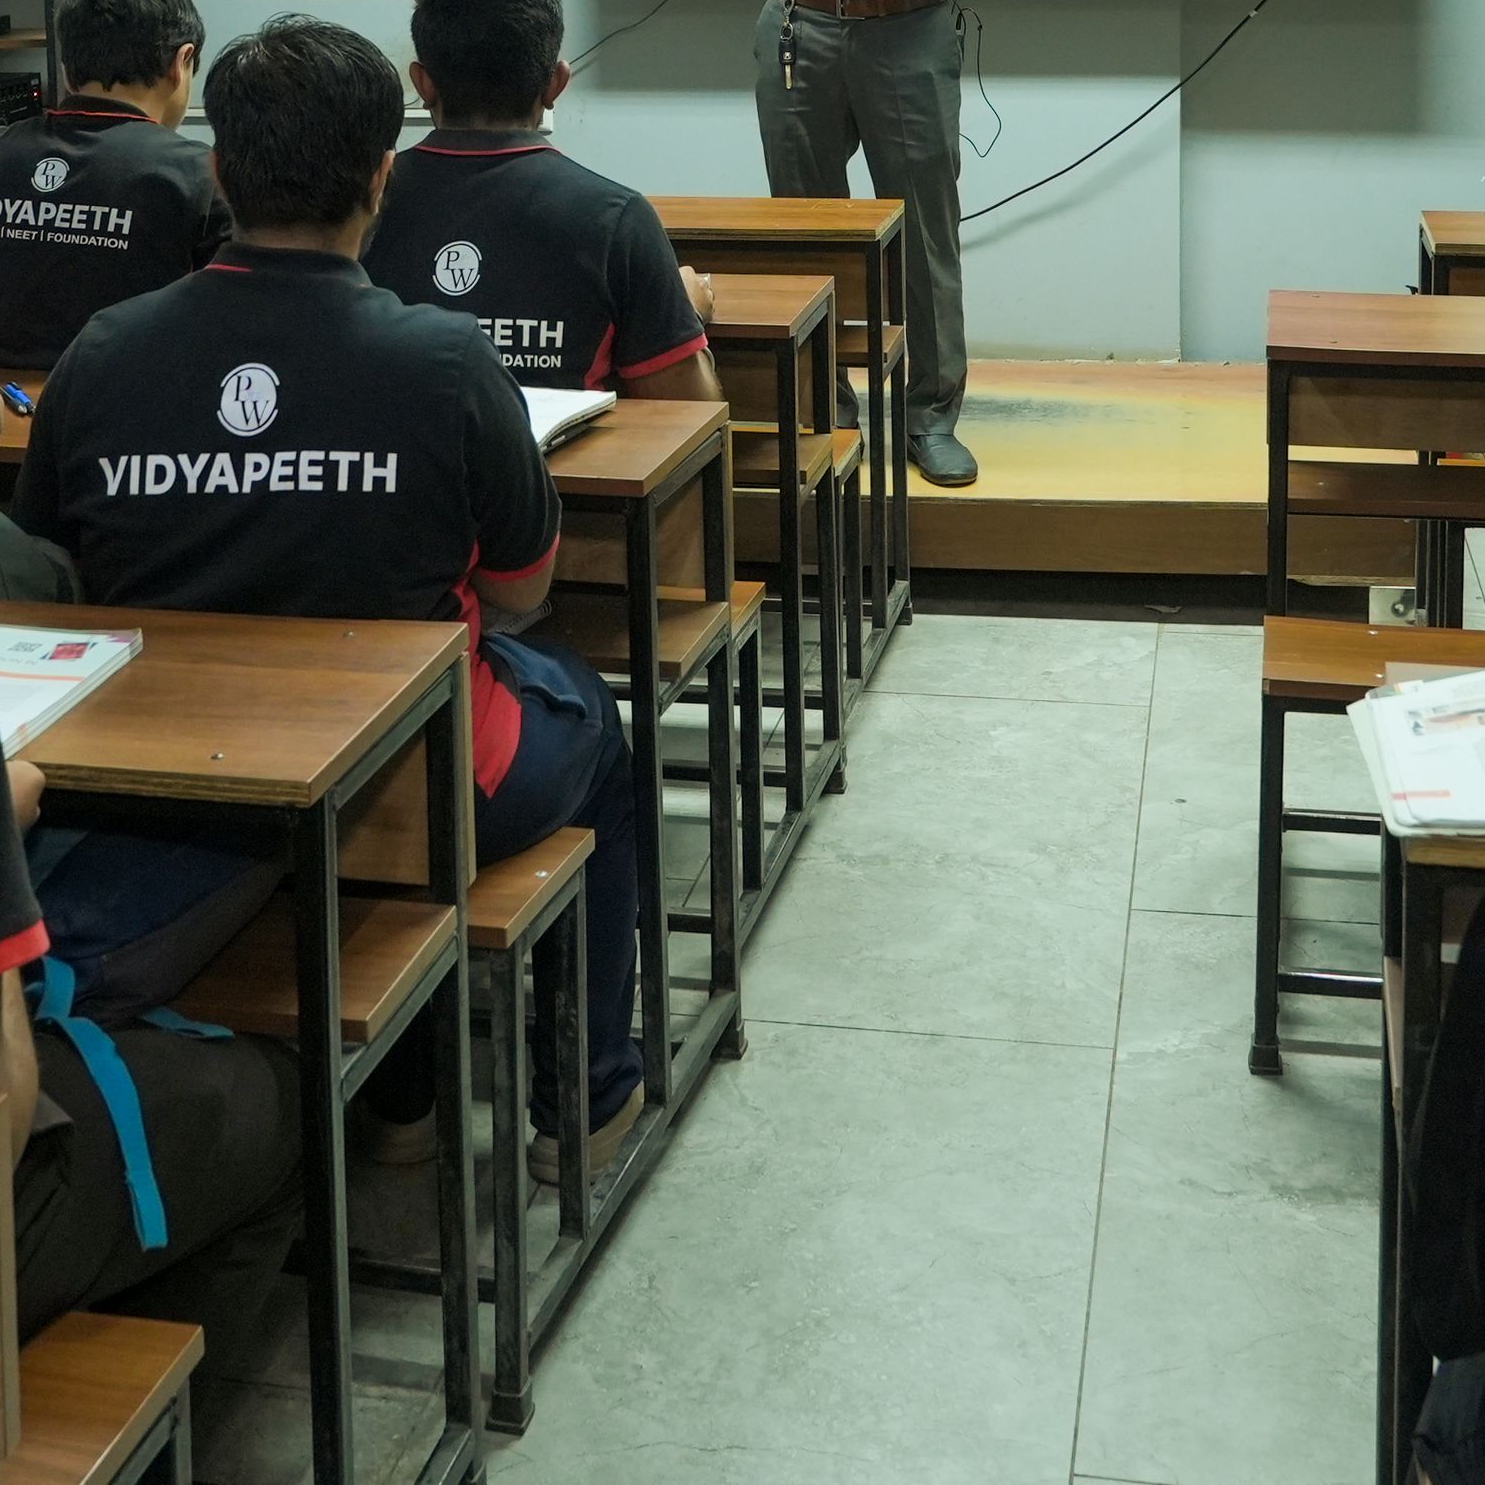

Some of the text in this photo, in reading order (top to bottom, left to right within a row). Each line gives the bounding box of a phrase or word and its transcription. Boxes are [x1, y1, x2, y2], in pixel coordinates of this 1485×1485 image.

[39, 160, 65, 190] PW
[6, 228, 37, 241] NEET
[47, 232, 129, 250] FOUNDATION
[441, 247, 476, 293] PW
[229, 370, 274, 432] PW
[98, 450, 398, 497] VIDYAPEETH
